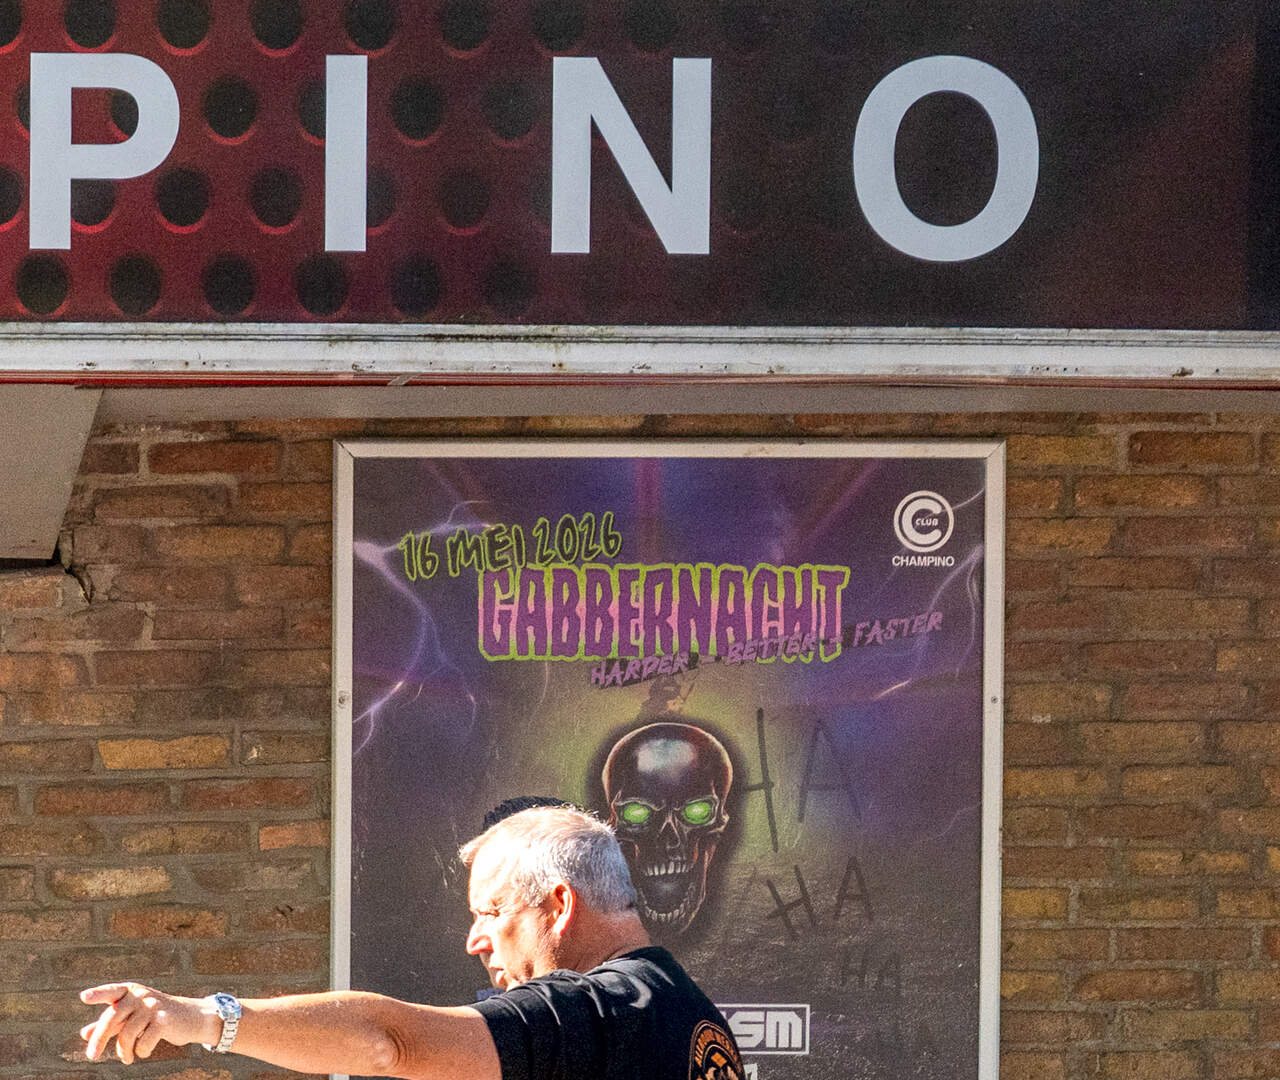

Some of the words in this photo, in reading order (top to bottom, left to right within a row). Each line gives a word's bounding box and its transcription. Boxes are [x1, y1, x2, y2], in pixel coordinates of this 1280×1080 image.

[398, 530, 439, 581] 16
[446, 523, 526, 578] MEI
[532, 511, 622, 567] 2026
[915, 518, 939, 526] CLUB
[891, 555, 955, 567] CHAMPINO
[478, 562, 851, 664] GABBERNACHT
[590, 651, 695, 688] HARDER
[853, 611, 943, 647] FASTER
[721, 1010, 803, 1049] SM
